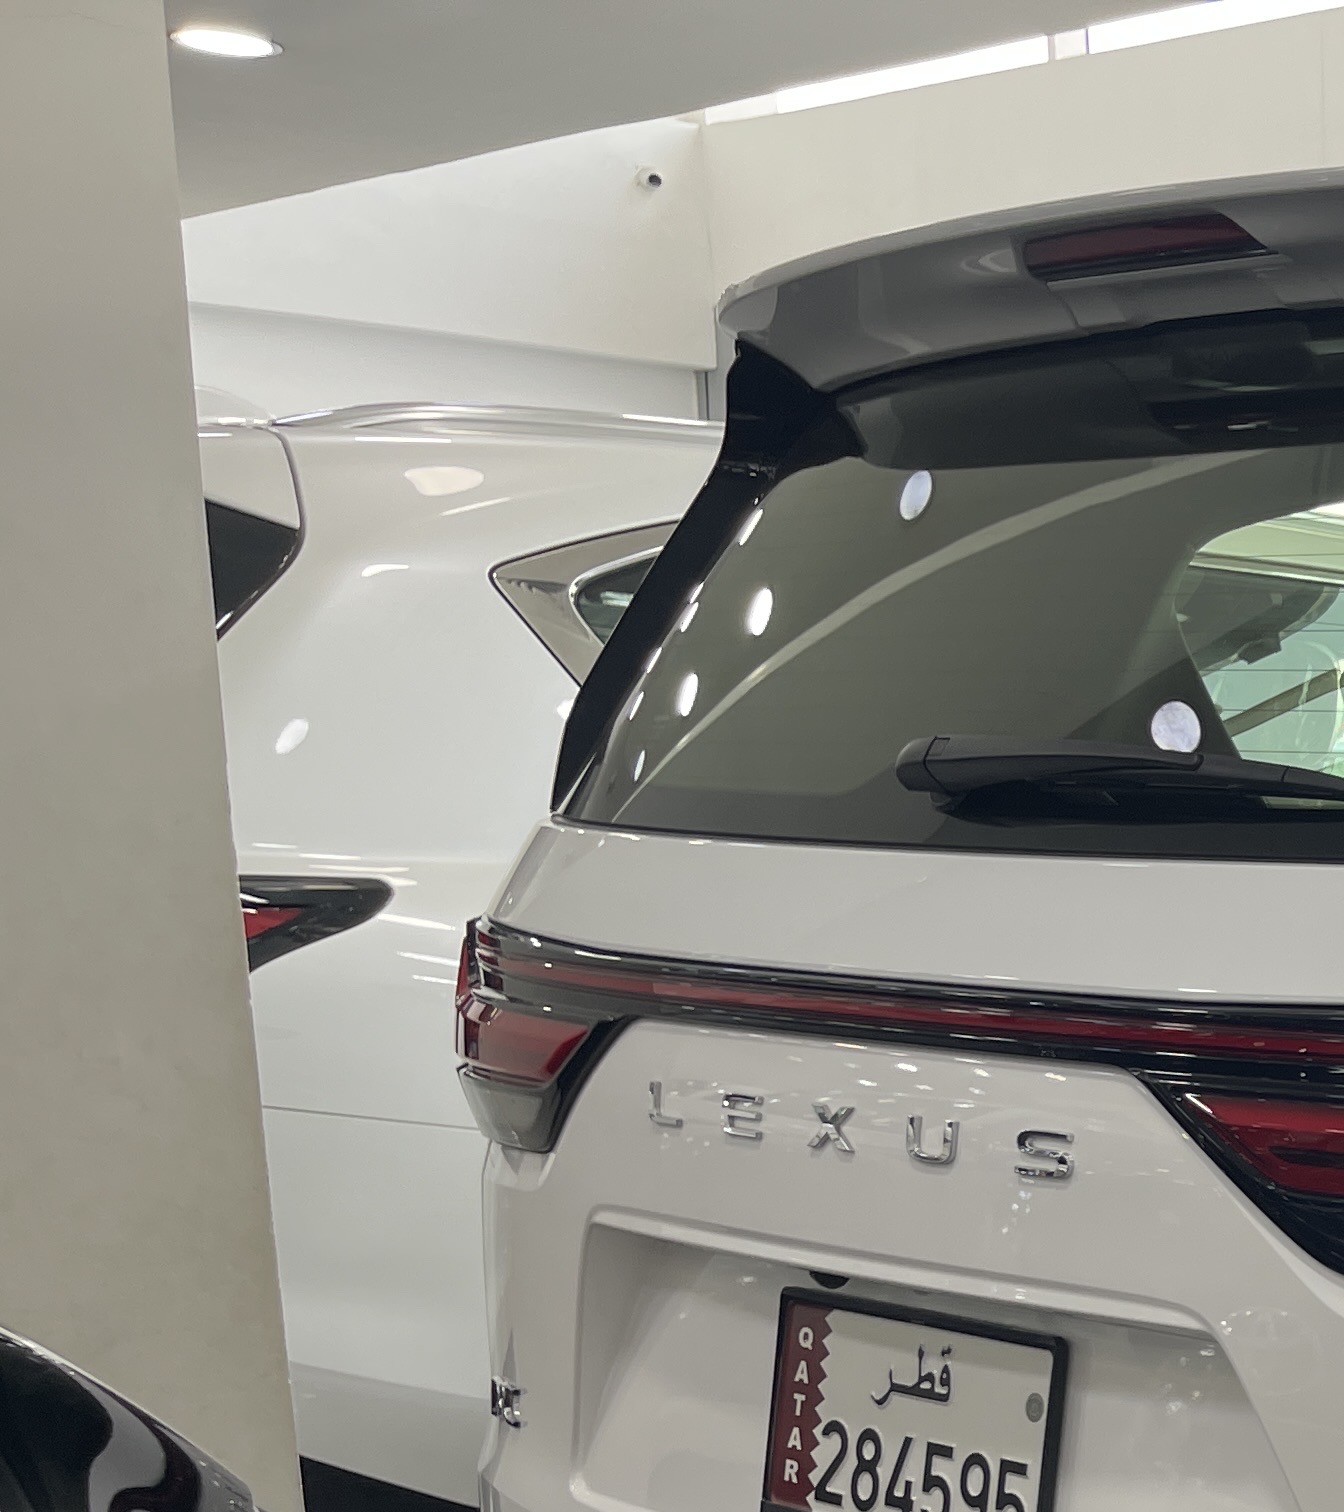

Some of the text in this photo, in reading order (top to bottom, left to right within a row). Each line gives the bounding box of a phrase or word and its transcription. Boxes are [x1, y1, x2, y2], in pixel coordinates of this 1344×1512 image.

[648, 1080, 1075, 1179] LEXUS
[783, 1326, 815, 1485] QATAR
[871, 1344, 953, 1406] قطر
